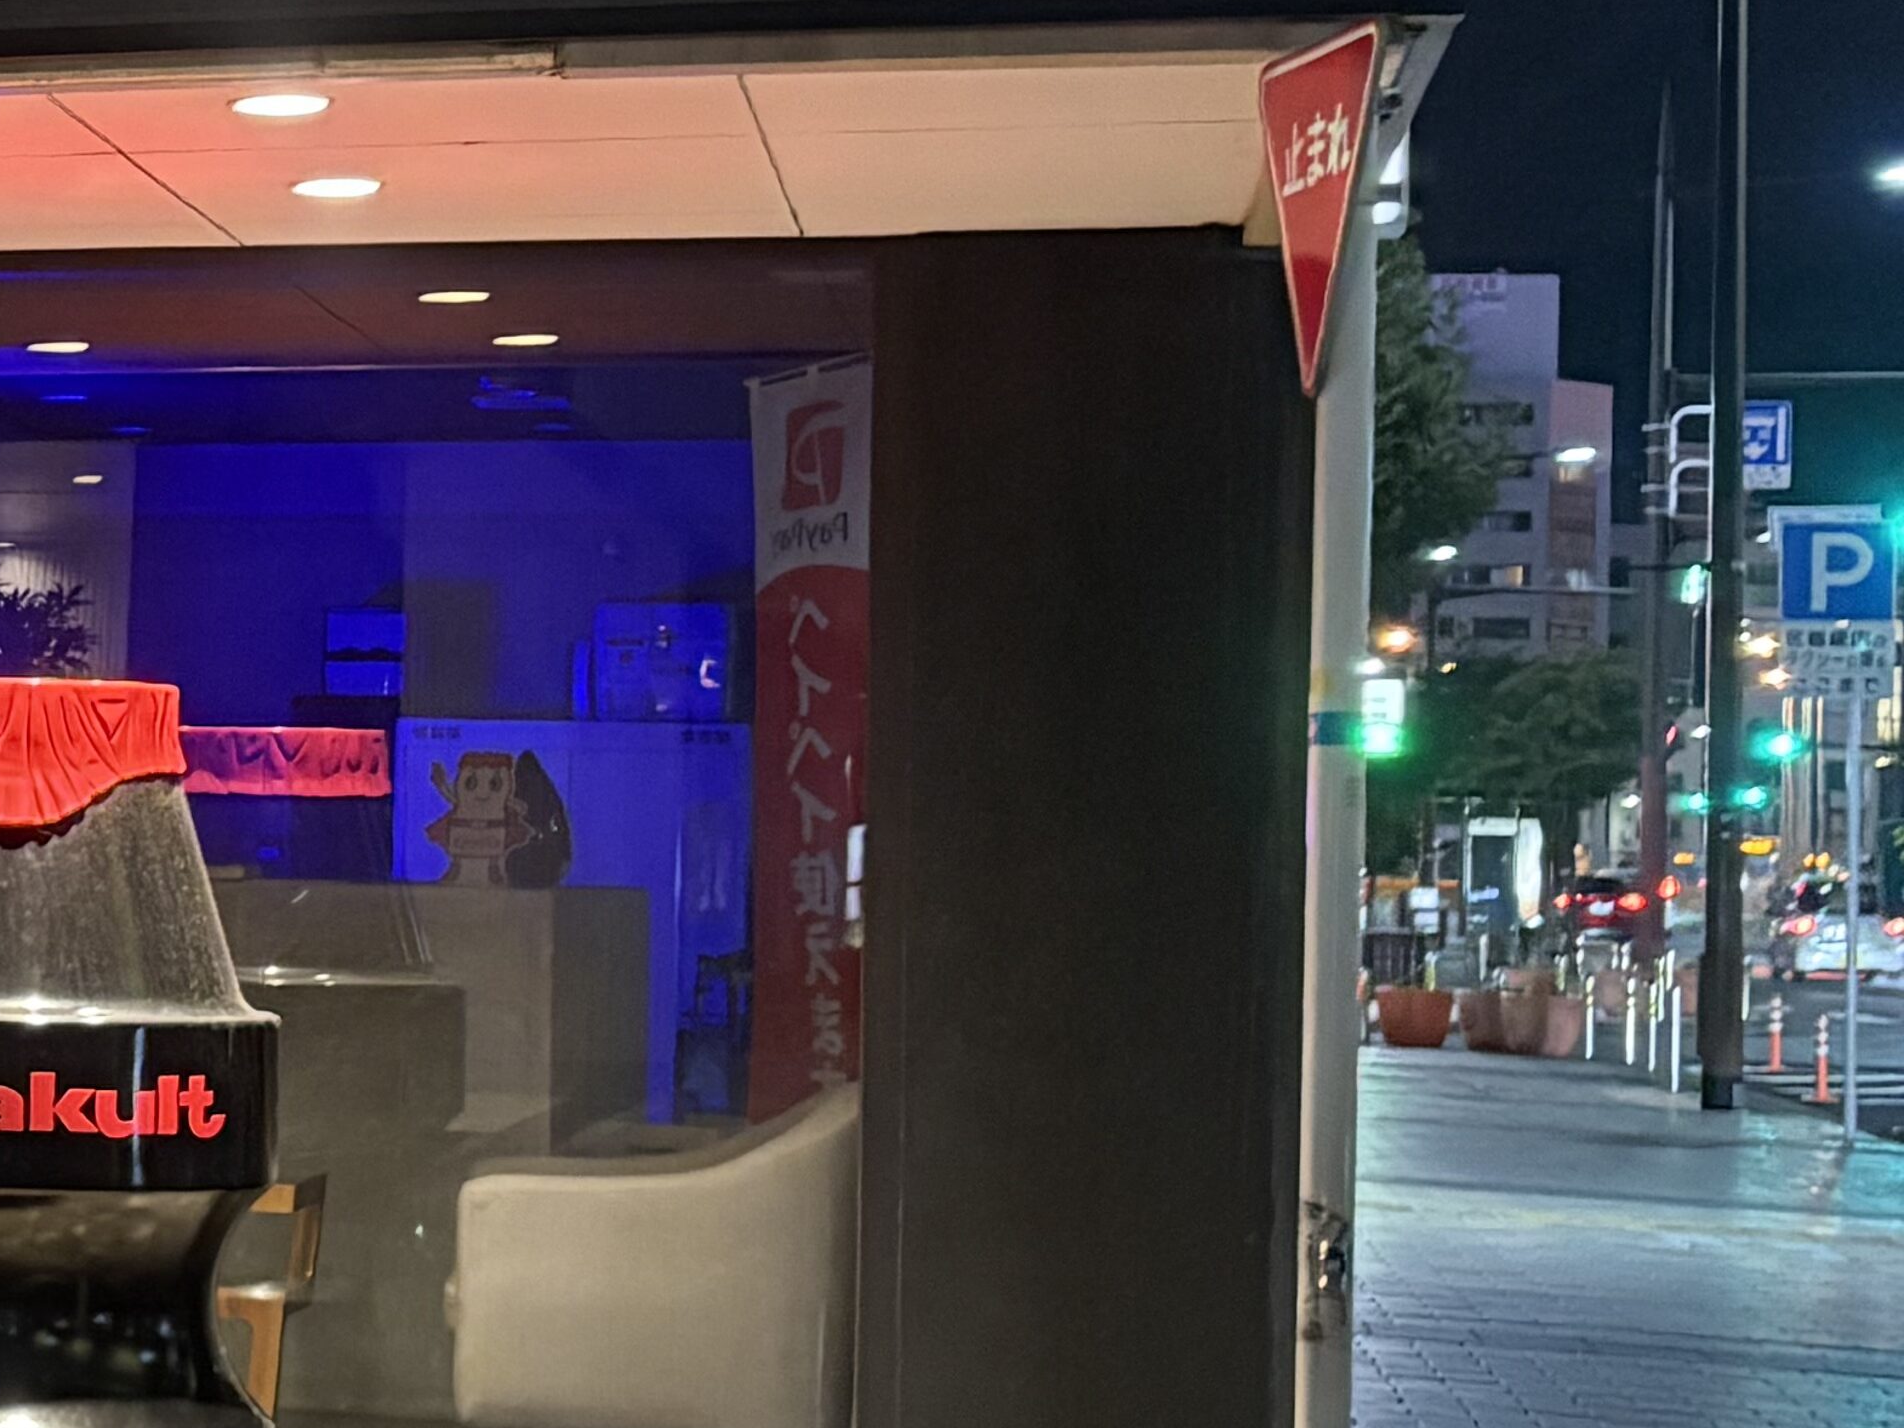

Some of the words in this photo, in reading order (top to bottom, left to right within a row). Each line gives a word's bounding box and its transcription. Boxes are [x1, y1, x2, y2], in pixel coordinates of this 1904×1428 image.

[1281, 102, 1352, 198] 止まれ
[1809, 531, 1874, 613] P
